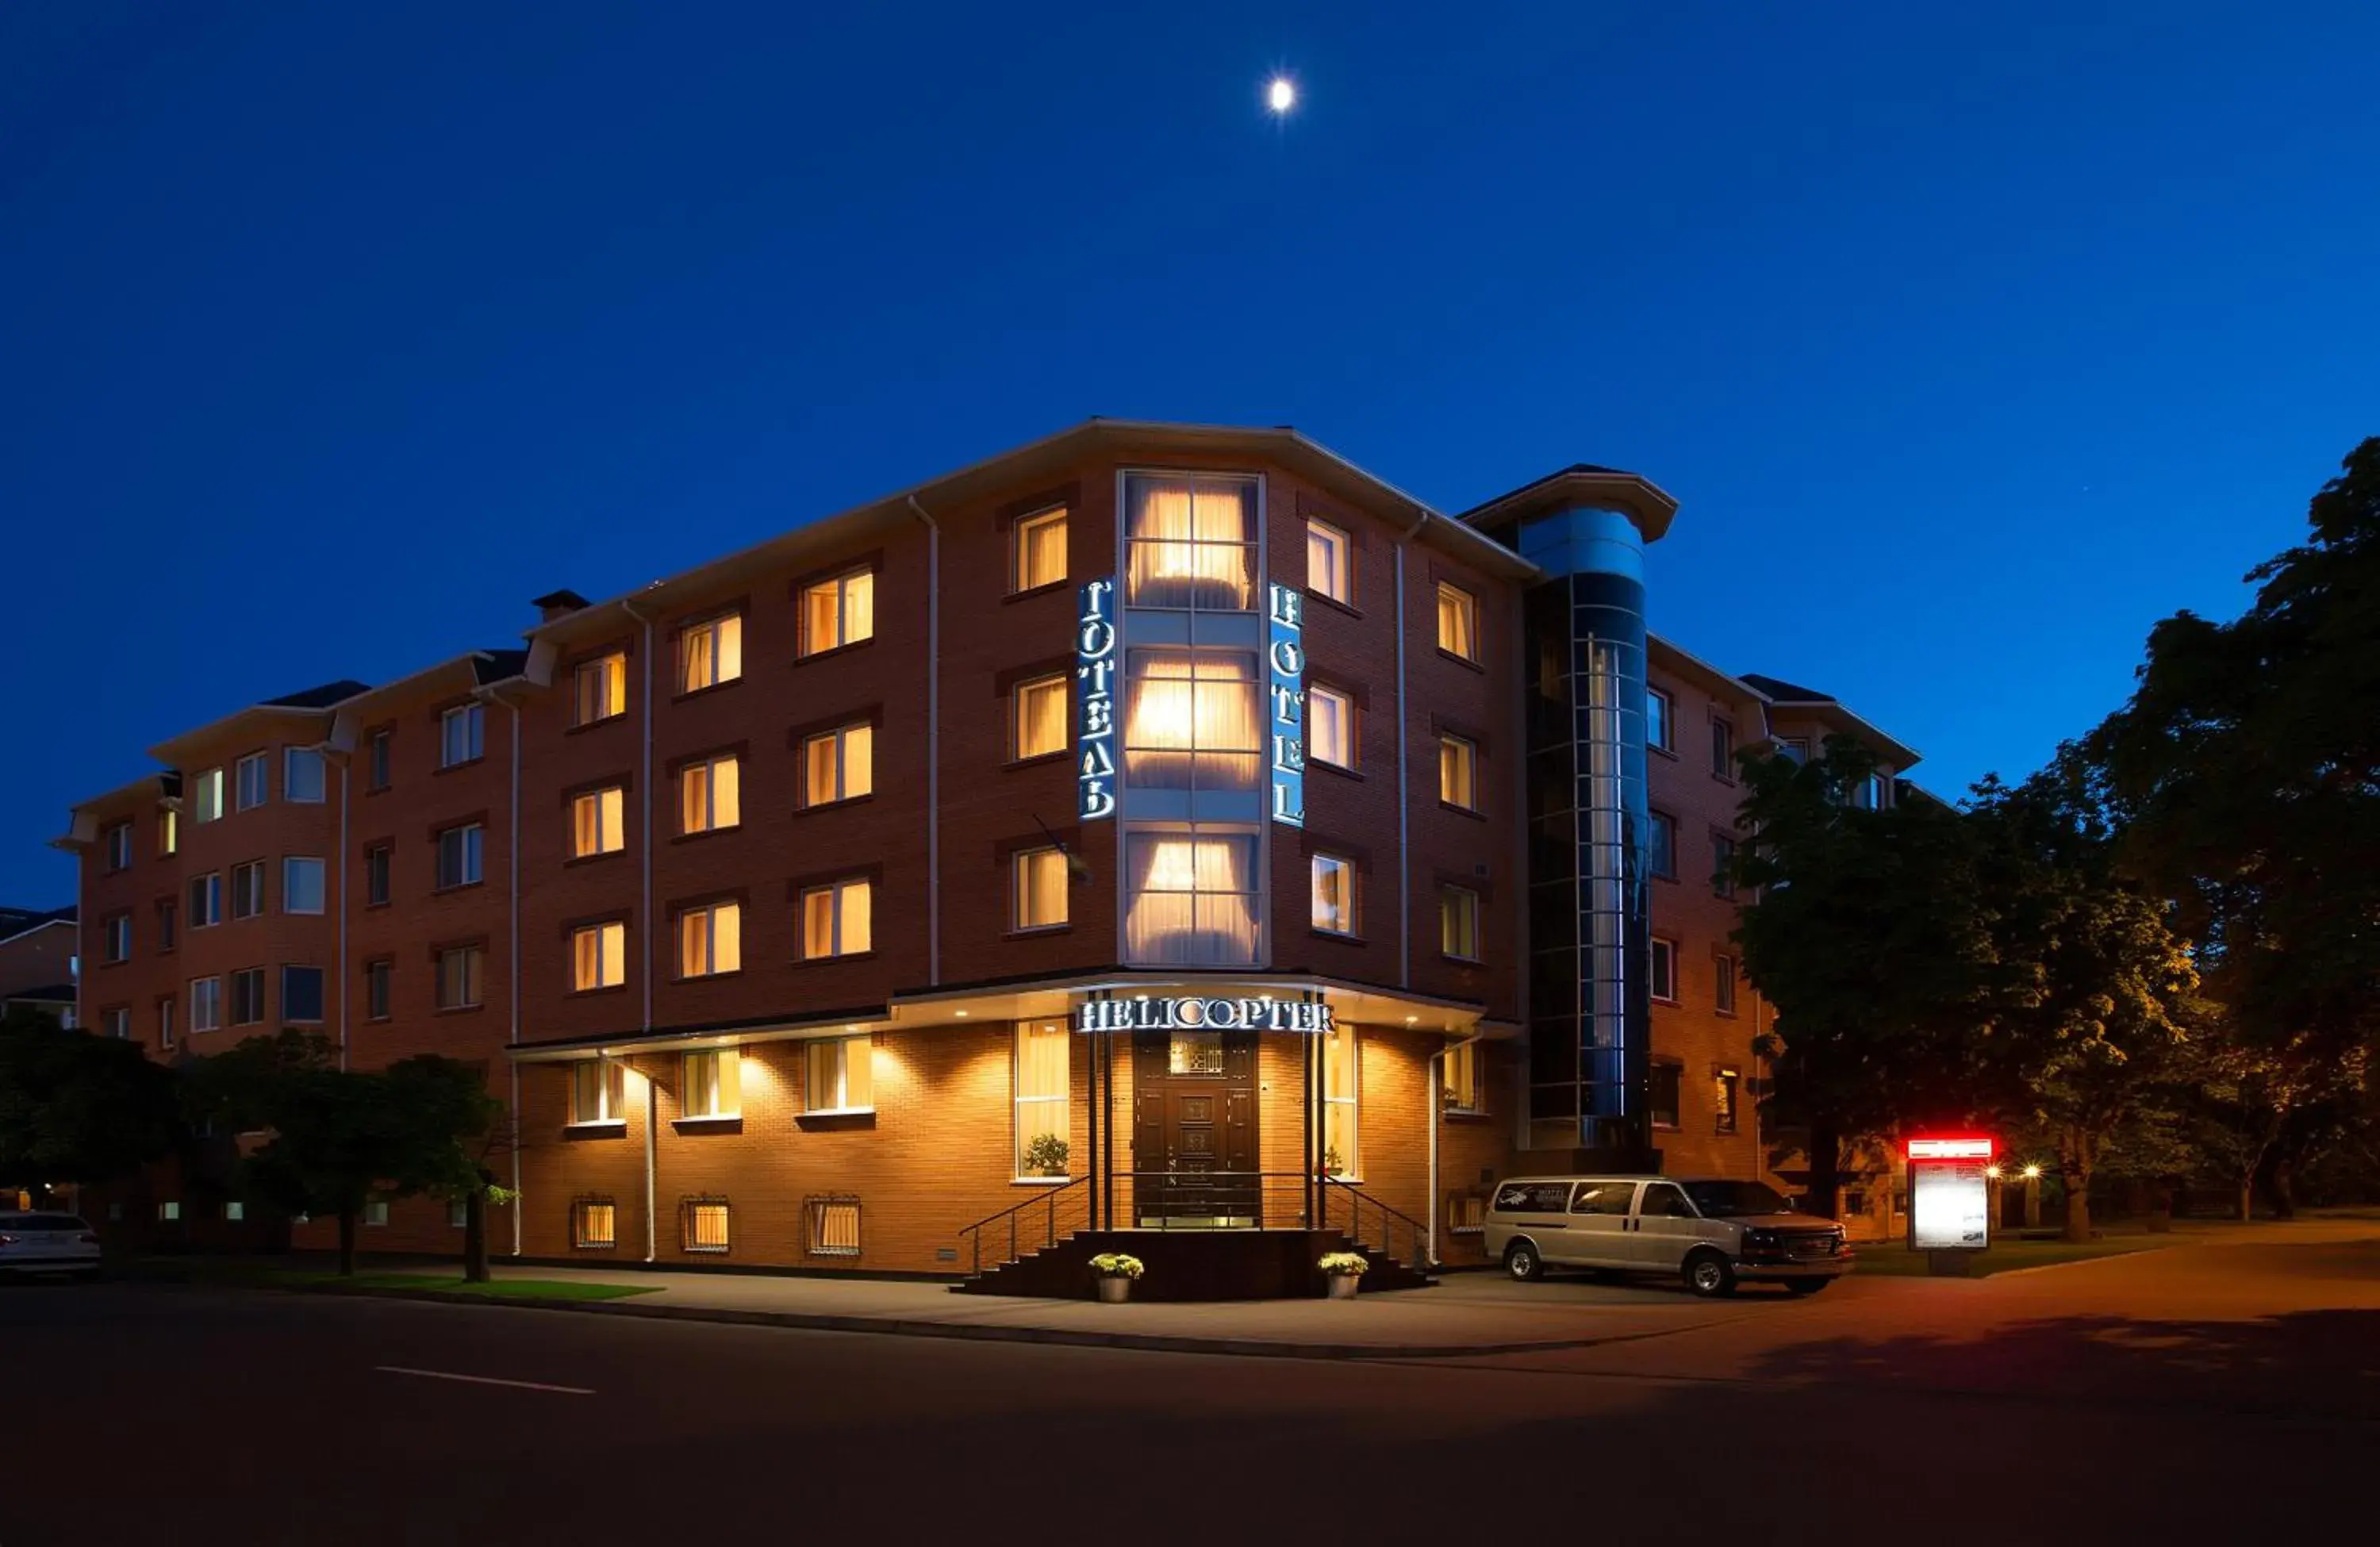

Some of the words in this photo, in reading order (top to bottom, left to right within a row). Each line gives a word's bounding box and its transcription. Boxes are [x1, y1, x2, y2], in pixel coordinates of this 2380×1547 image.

[1078, 582, 1115, 820] ГОТЕЛЬ
[1269, 585, 1305, 827] HOTEL
[1078, 997, 1336, 1032] HELICOPTER
